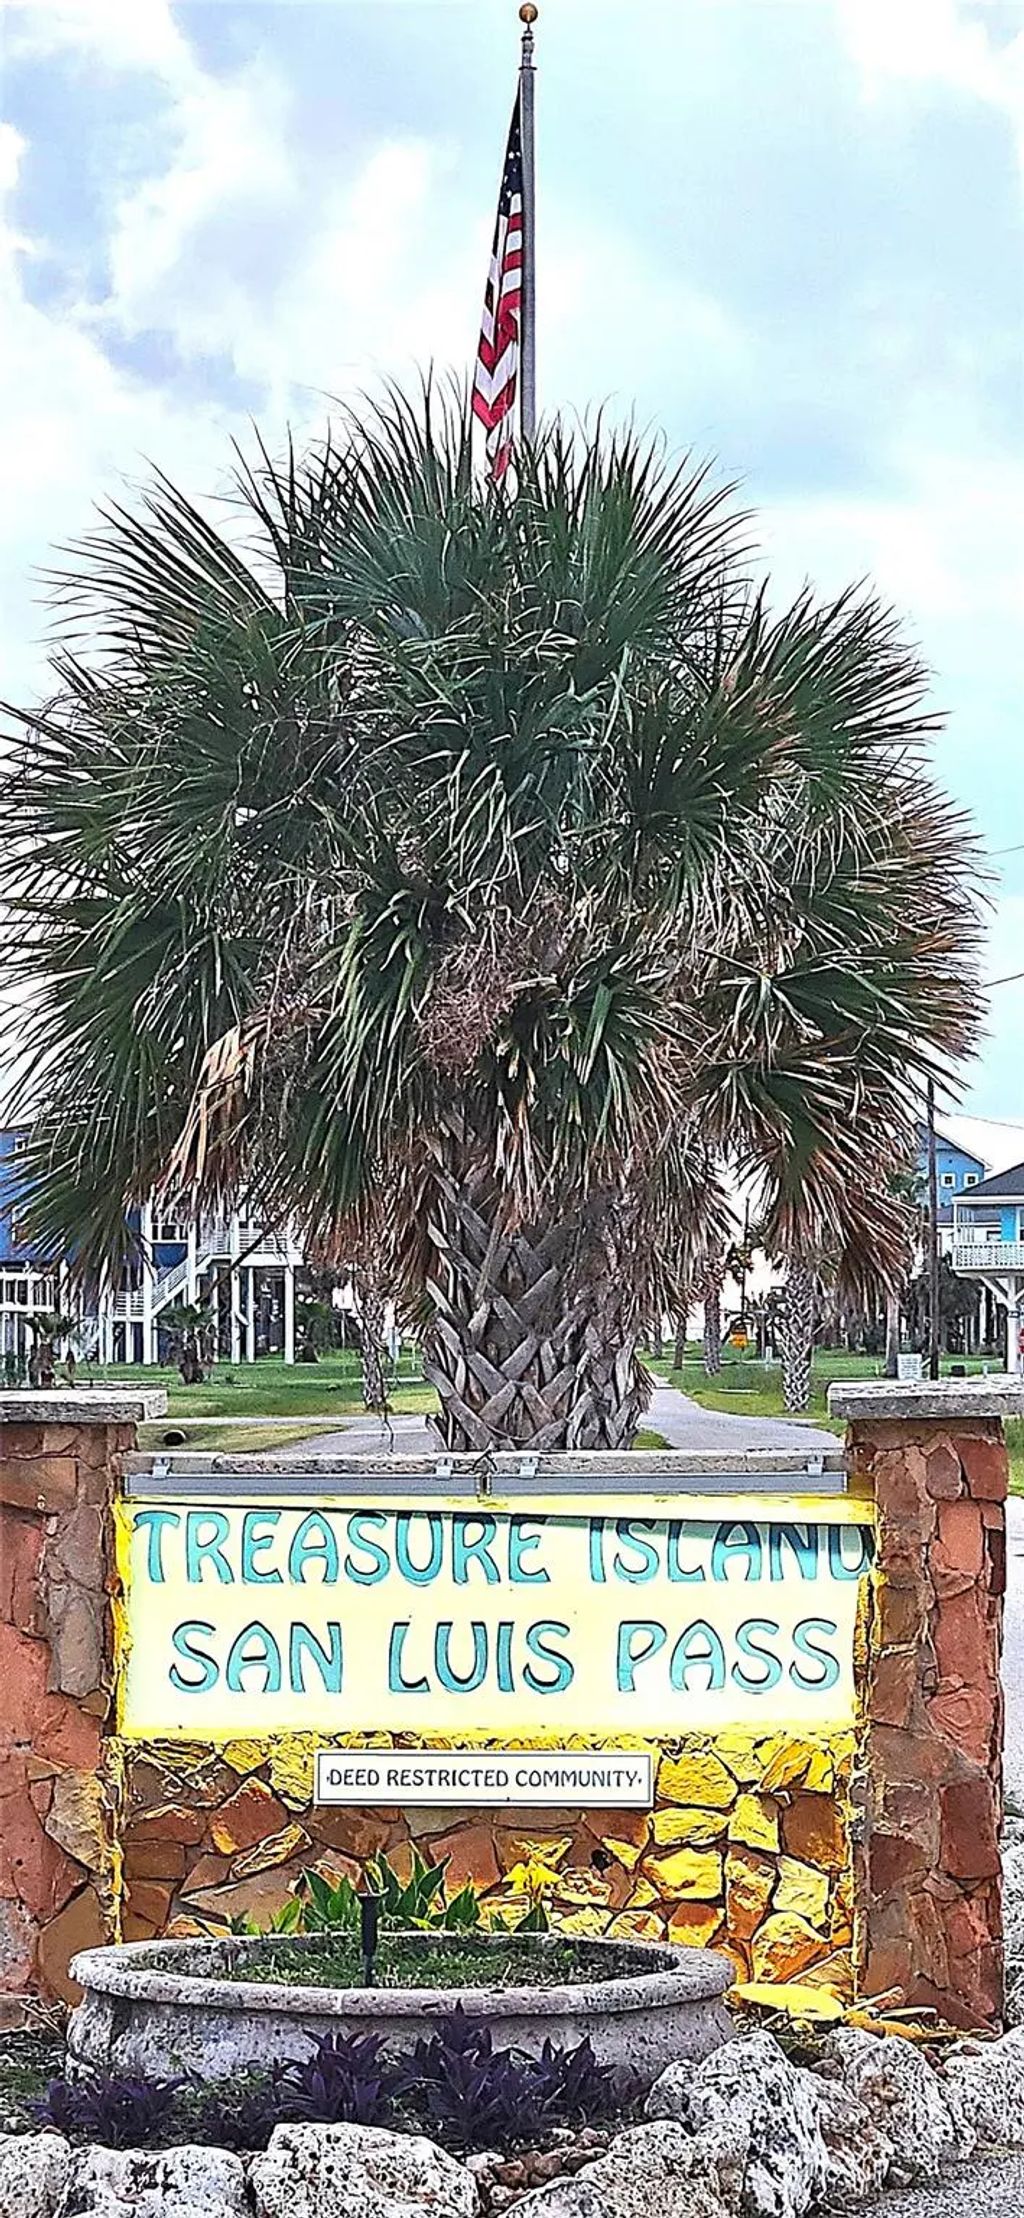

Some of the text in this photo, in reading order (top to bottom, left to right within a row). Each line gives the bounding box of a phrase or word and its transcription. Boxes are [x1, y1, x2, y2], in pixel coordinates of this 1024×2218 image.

[131, 1510, 876, 1587] TREASURE ISLAND
[168, 1617, 841, 1695] SAN LUIS PASS
[329, 1768, 638, 1787] DEED RESTRICTED COMMUNITY
